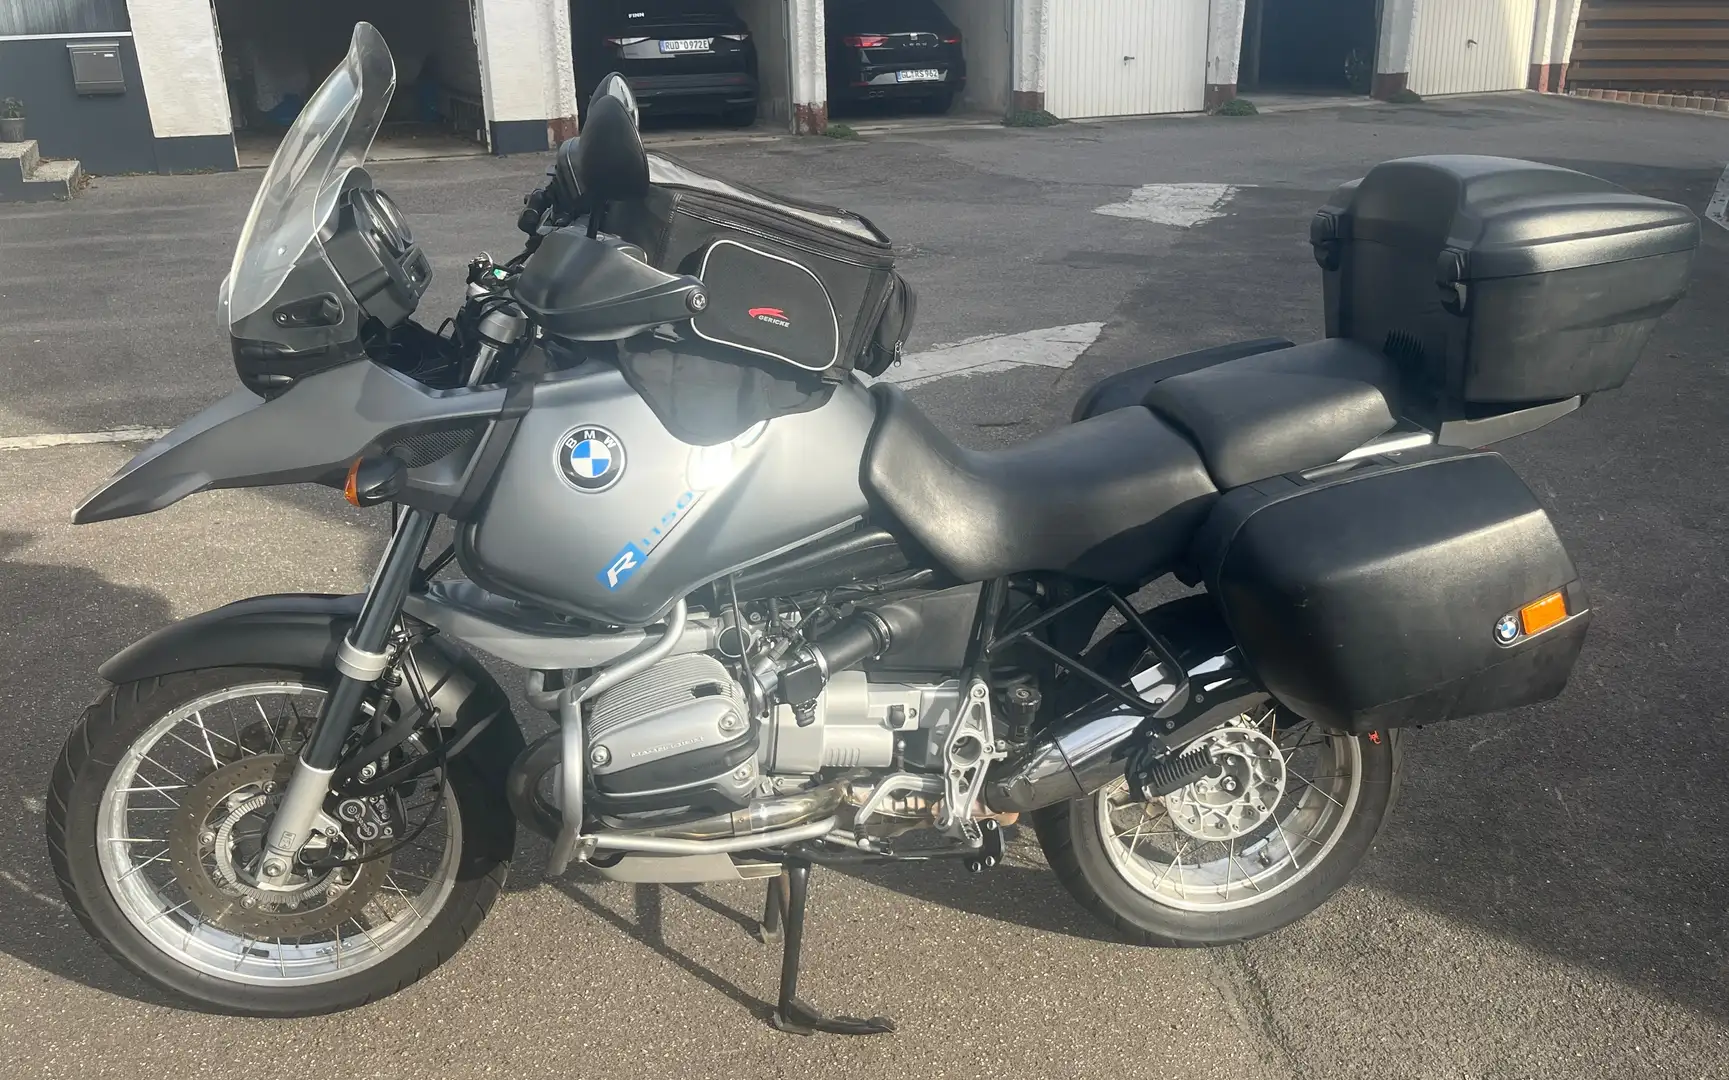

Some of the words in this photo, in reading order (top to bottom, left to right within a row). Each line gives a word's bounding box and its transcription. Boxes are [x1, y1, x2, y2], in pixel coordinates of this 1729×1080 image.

[665, 41, 680, 50] RUD
[758, 314, 791, 328] GERICKE
[565, 430, 617, 450] BMW
